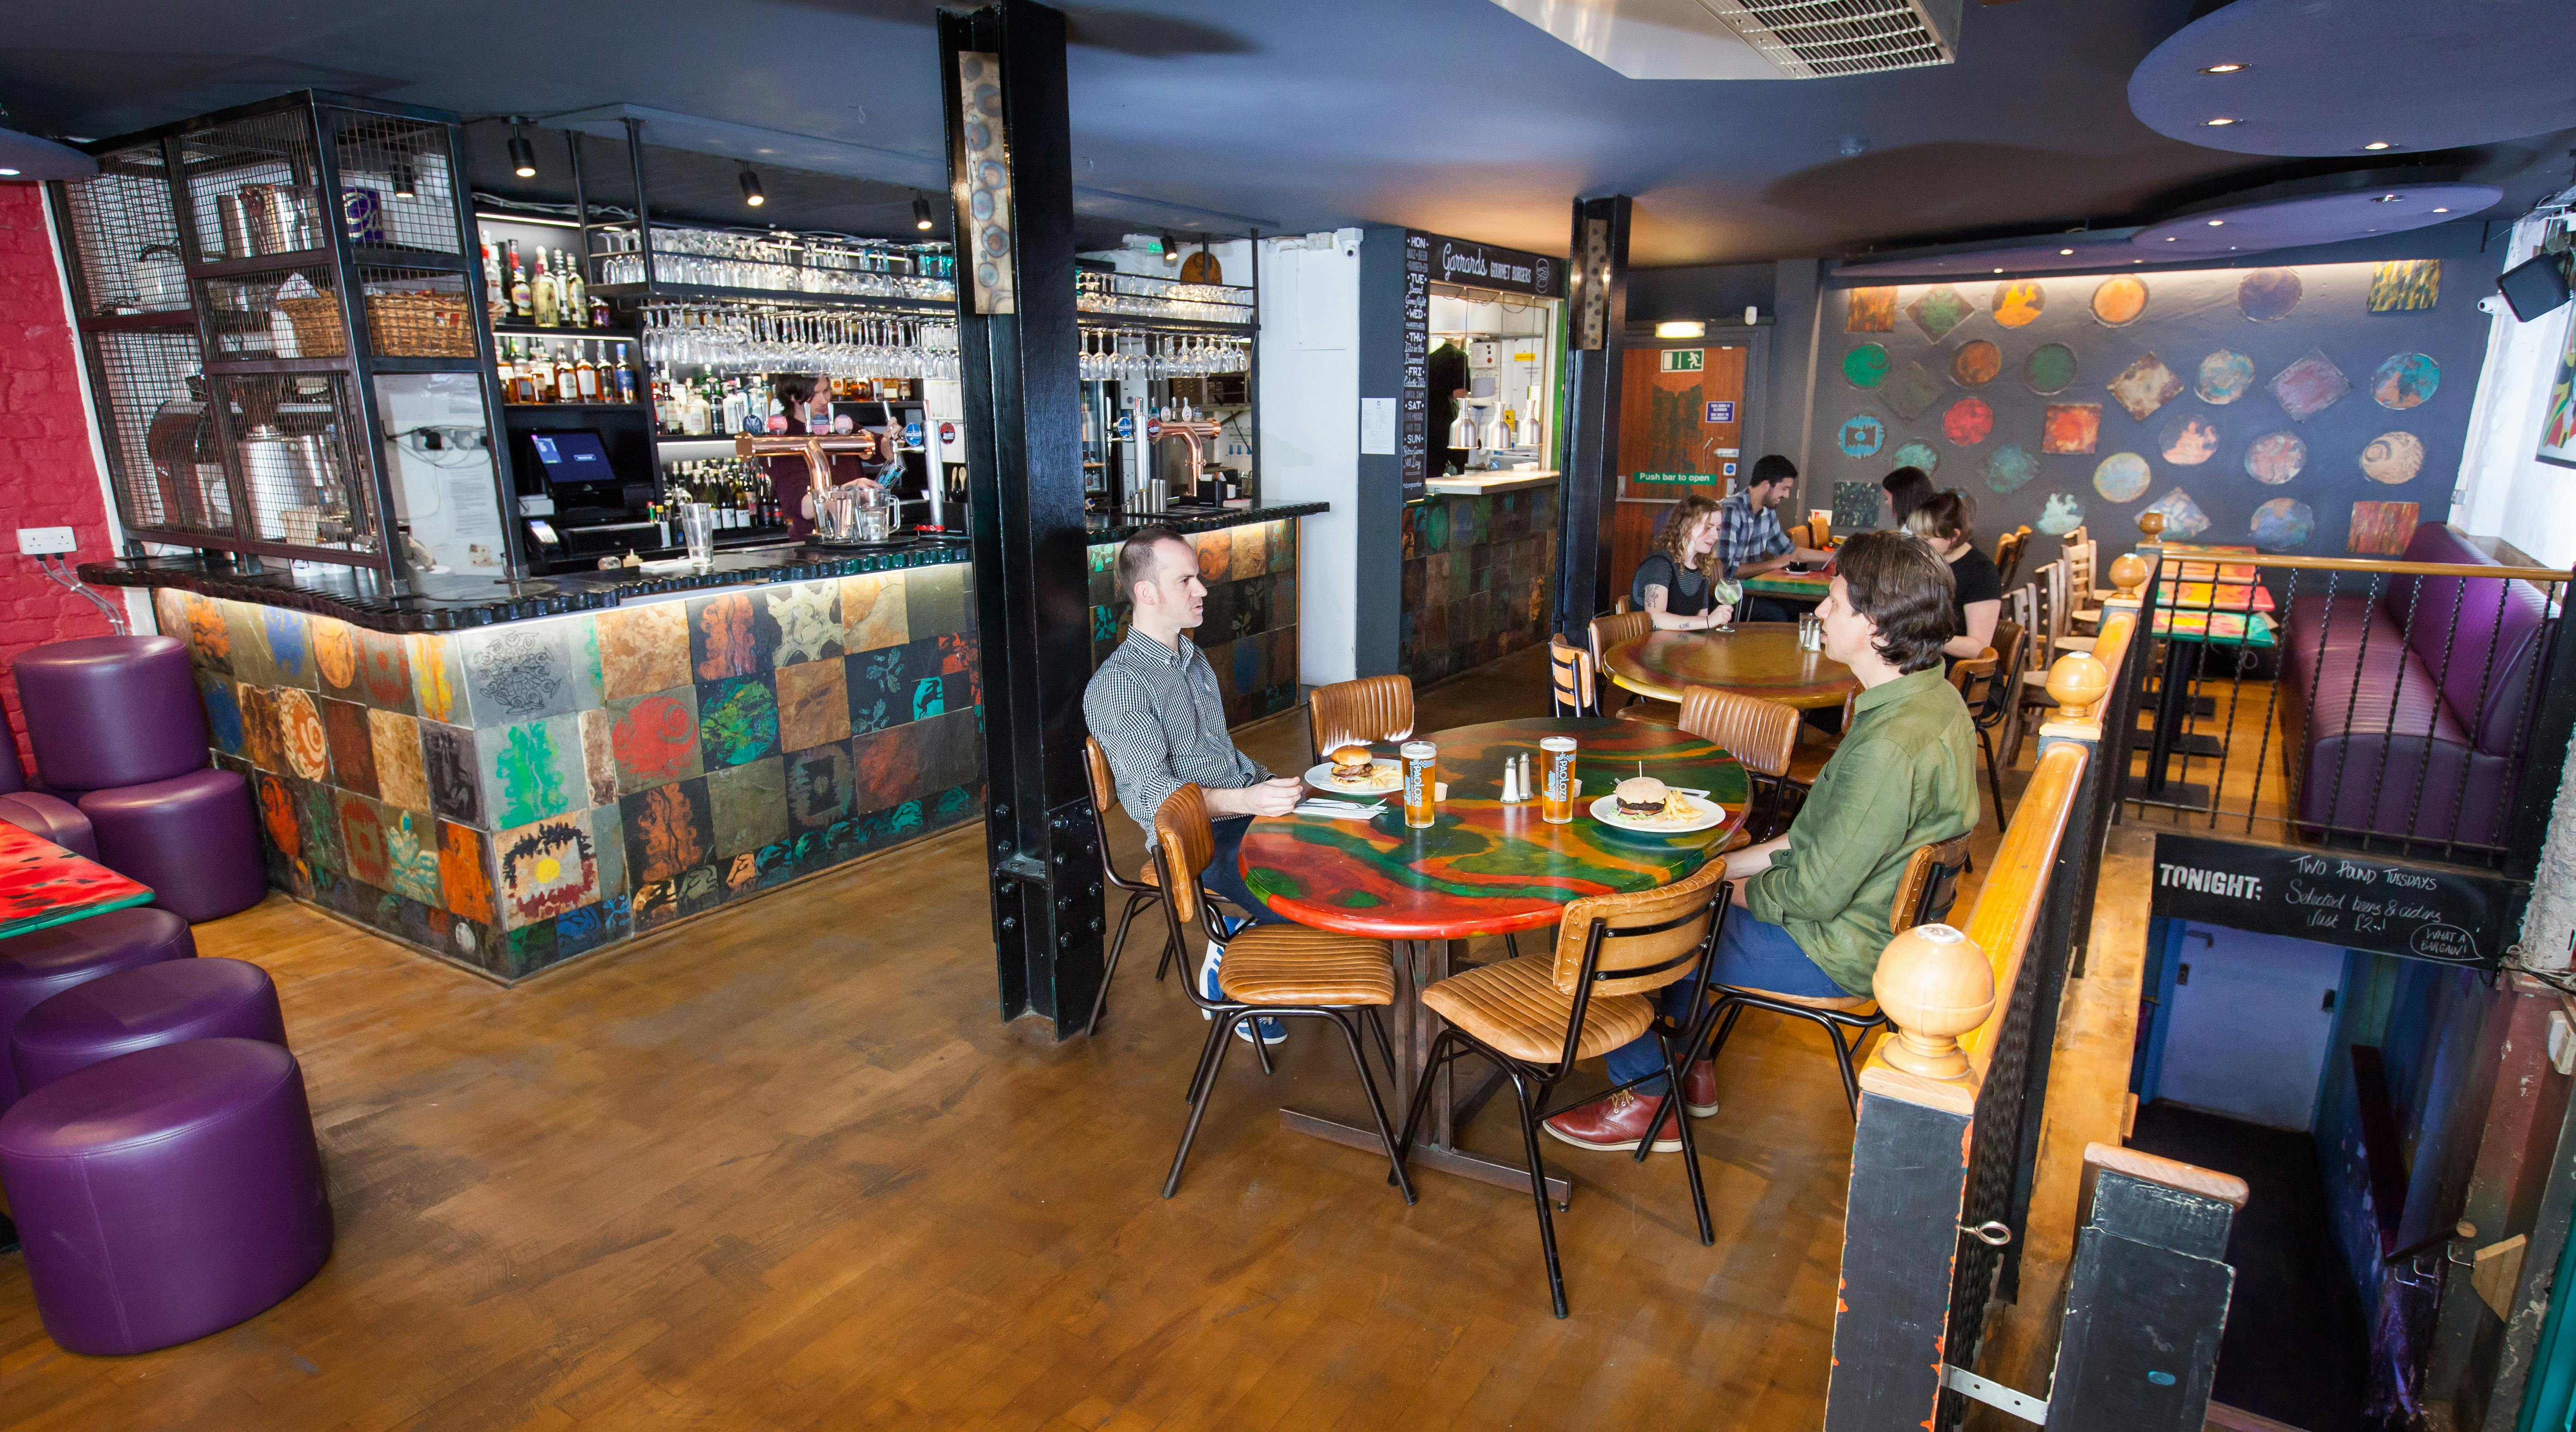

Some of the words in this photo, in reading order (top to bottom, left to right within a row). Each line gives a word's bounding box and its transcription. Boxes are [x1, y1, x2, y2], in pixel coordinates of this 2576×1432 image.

[1443, 242, 1487, 281] Garrards
[1410, 273, 1424, 284] TUE
[1409, 308, 1423, 319] WED
[1409, 332, 1423, 342] THU
[1408, 366, 1422, 376] FRI
[1408, 400, 1421, 410] SAT
[1407, 434, 1421, 444] SUN
[1640, 472, 1660, 481] Push
[2290, 855, 2327, 875] TWO
[2337, 860, 2376, 884] POUND
[2383, 868, 2437, 890] TUESDAYS
[2160, 863, 2263, 901] TONIGHT:
[2286, 879, 2346, 910] Selected
[2353, 895, 2382, 916] beers
[2385, 899, 2398, 917] &
[2399, 902, 2442, 923] ciders
[2426, 927, 2457, 942] WHAT
[2458, 934, 2466, 943] A
